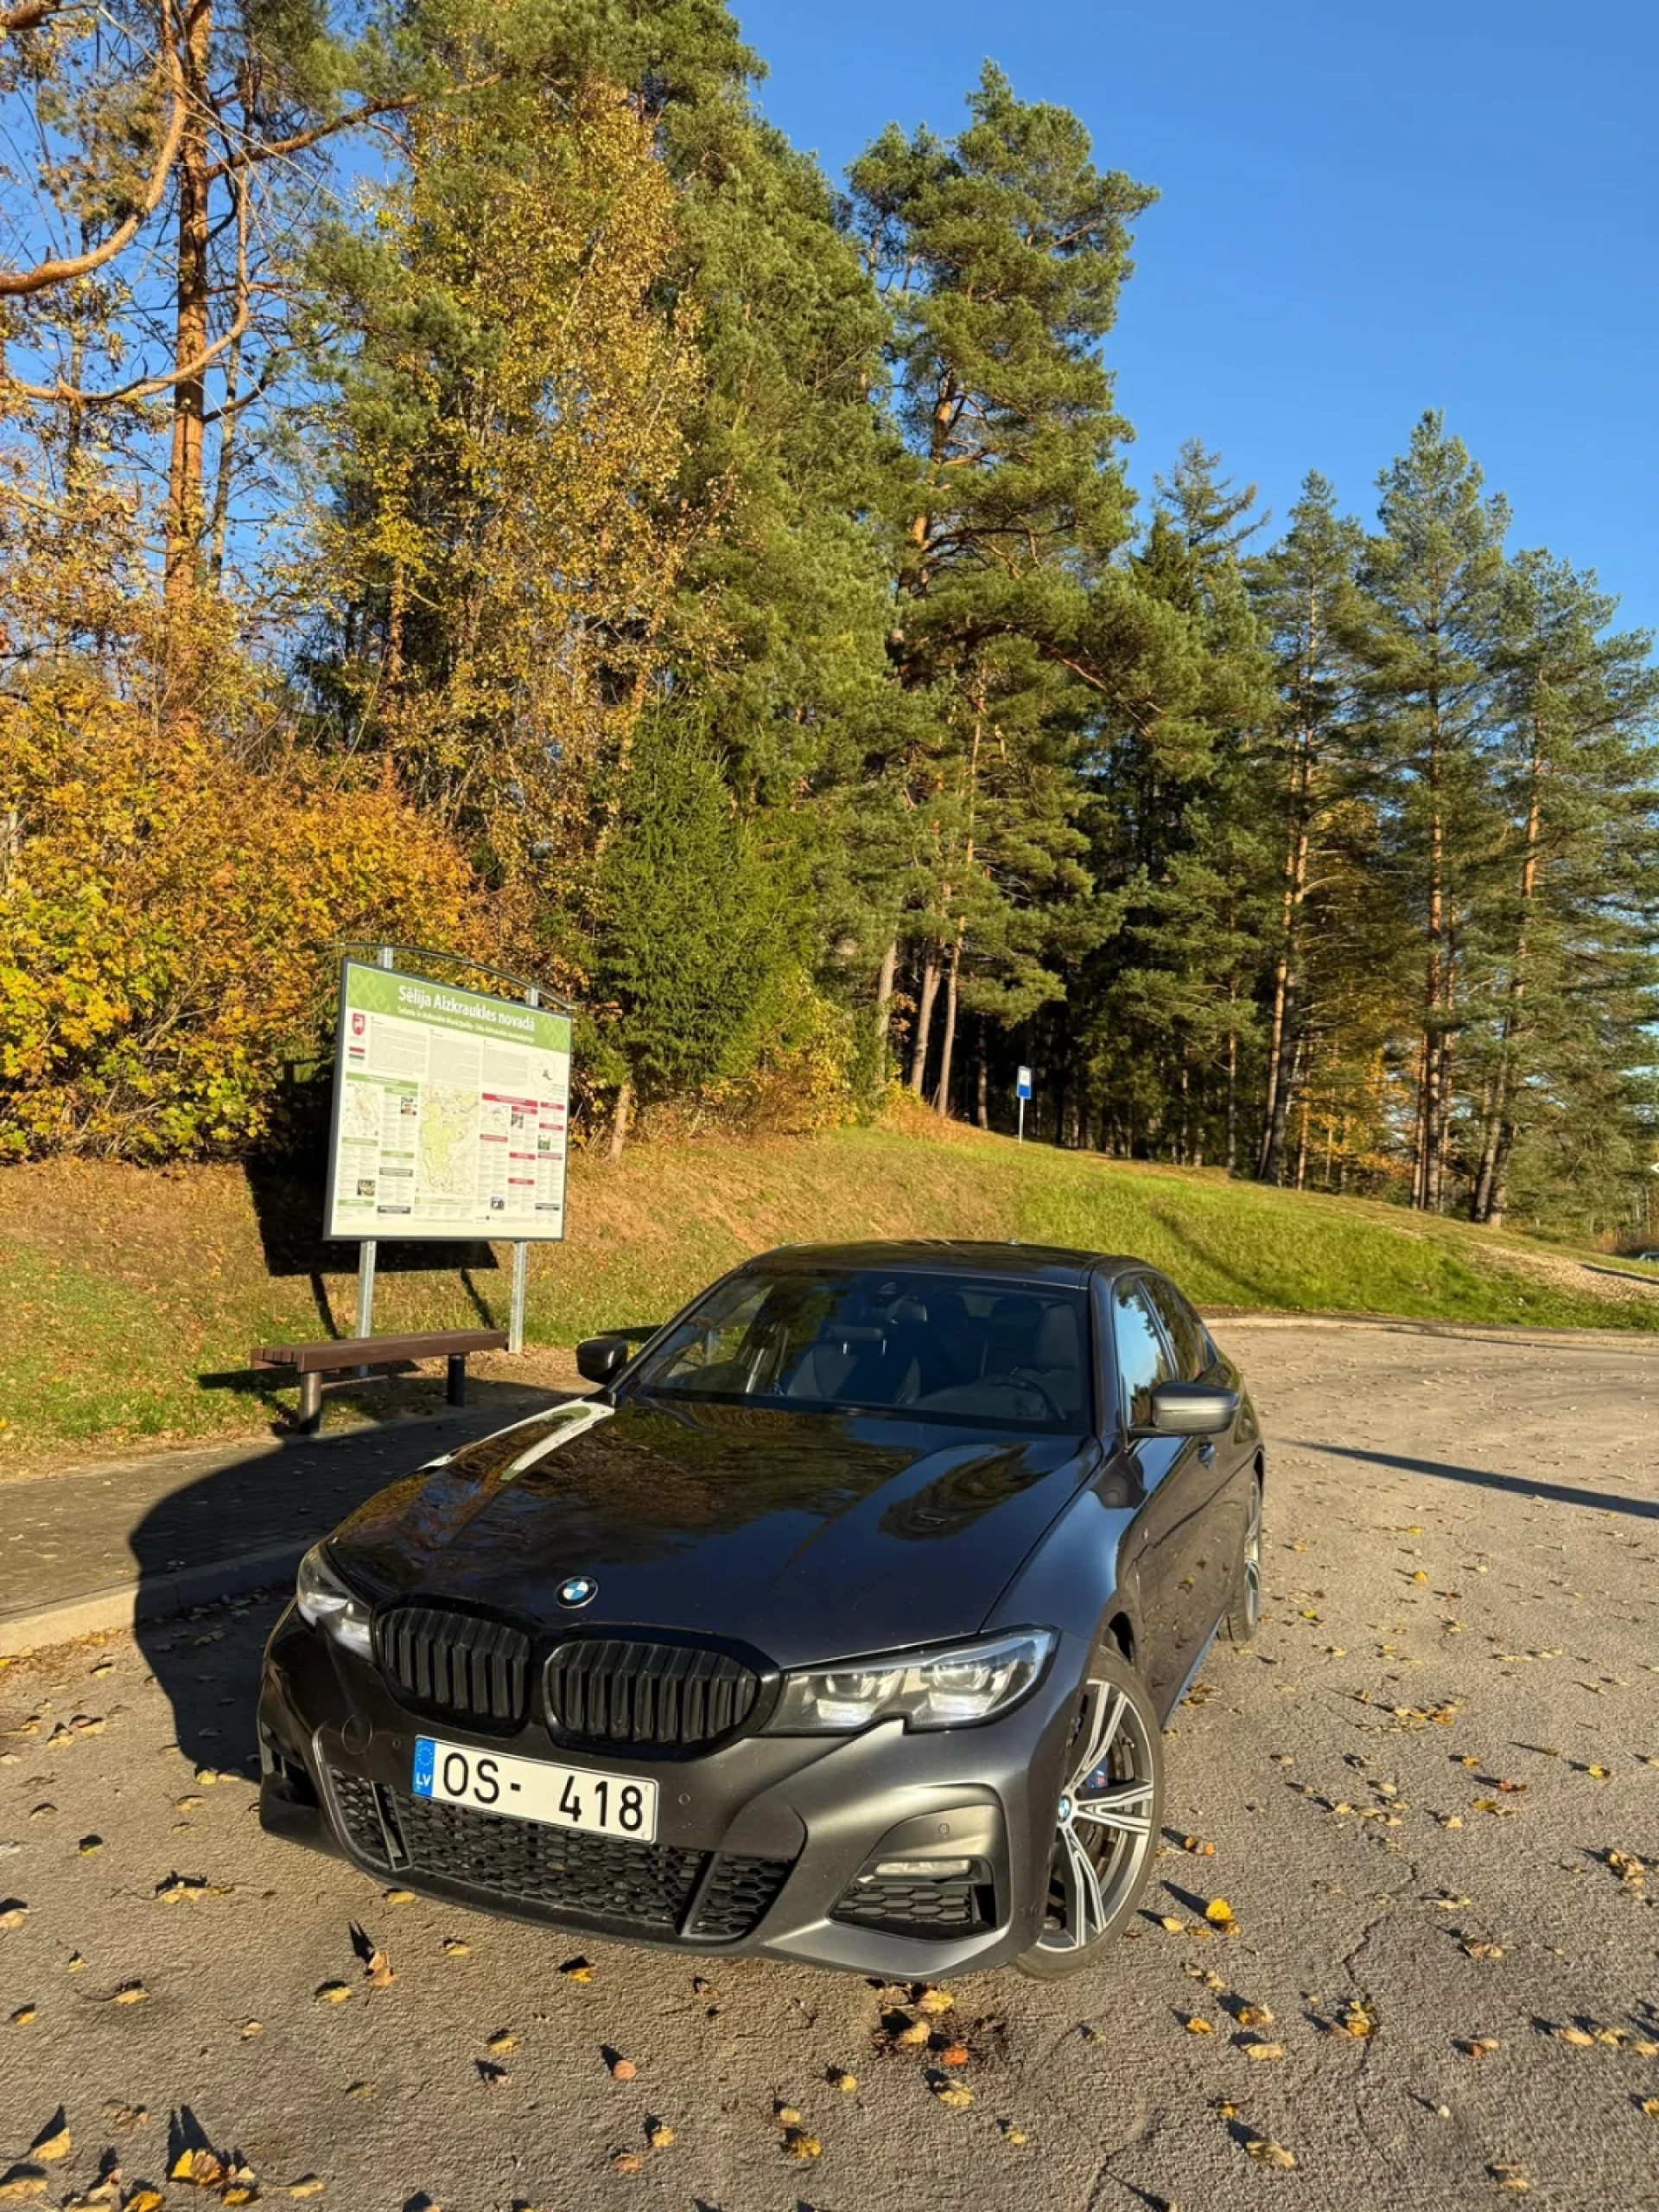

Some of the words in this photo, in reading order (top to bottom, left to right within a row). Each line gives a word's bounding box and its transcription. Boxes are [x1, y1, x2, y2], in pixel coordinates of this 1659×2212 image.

[398, 985, 431, 1009] Sēlija
[433, 995, 497, 1021] Aizkraukles
[498, 1012, 535, 1032] novadā
[416, 1772, 431, 1787] LV
[559, 1776, 643, 1831] 418
